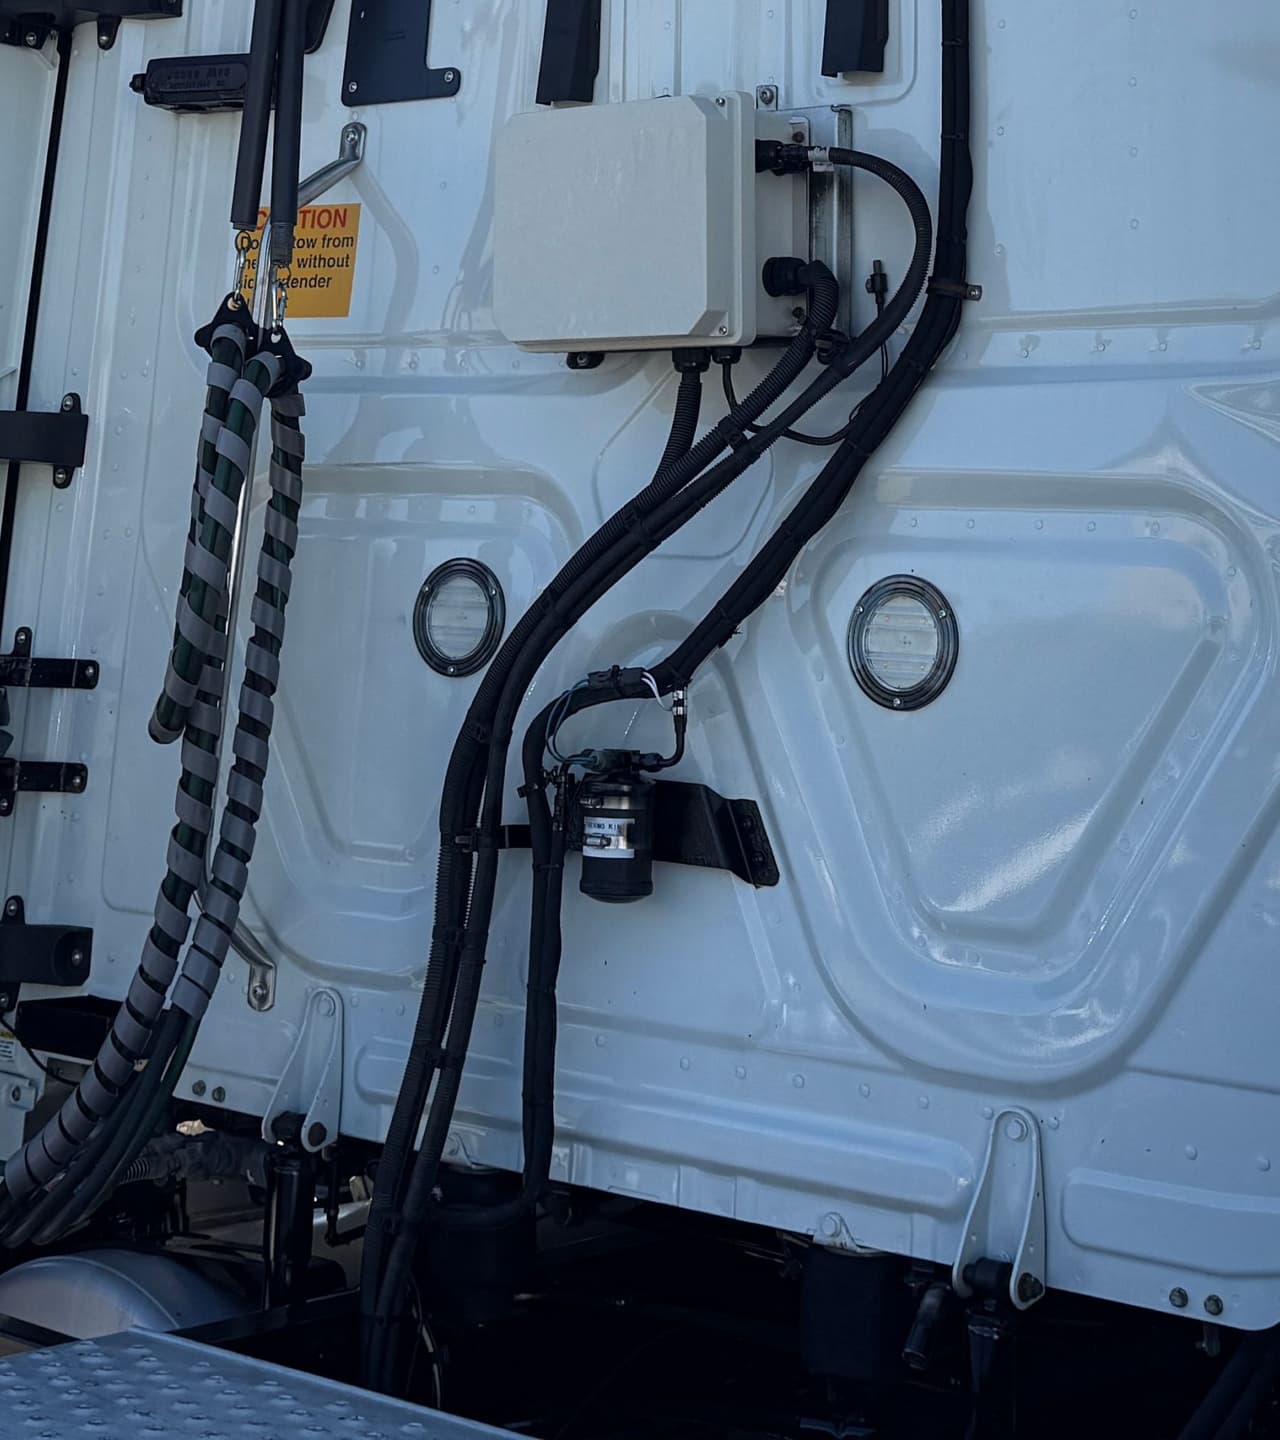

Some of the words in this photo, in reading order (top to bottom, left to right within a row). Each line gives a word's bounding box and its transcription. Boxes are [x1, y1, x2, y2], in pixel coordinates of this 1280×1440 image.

[256, 208, 347, 231] CTION
[322, 234, 354, 249] from
[297, 255, 350, 268] without
